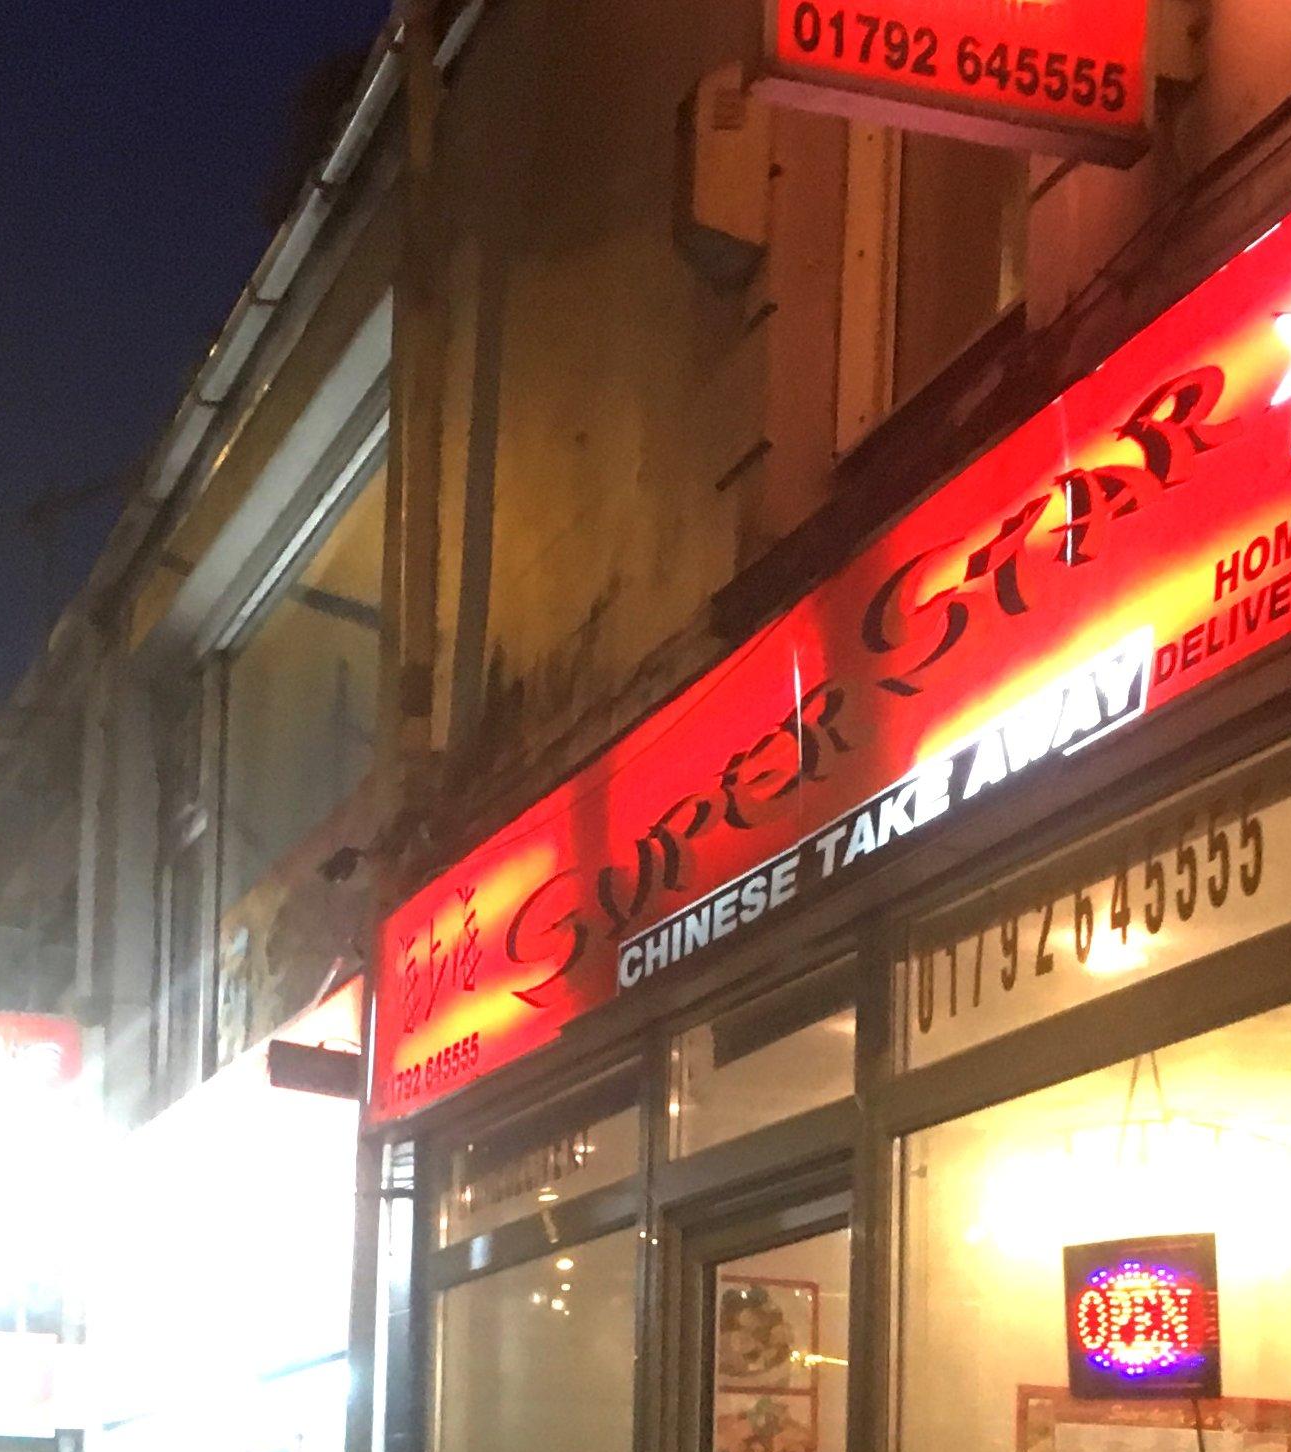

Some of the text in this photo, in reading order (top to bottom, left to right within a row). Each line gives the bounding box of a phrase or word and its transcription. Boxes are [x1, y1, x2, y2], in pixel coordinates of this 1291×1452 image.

[793, 1, 1126, 112] 01792 645555
[619, 640, 1144, 988] CHINESE TAKE AWAY
[1077, 1287, 1193, 1350] OPEN
